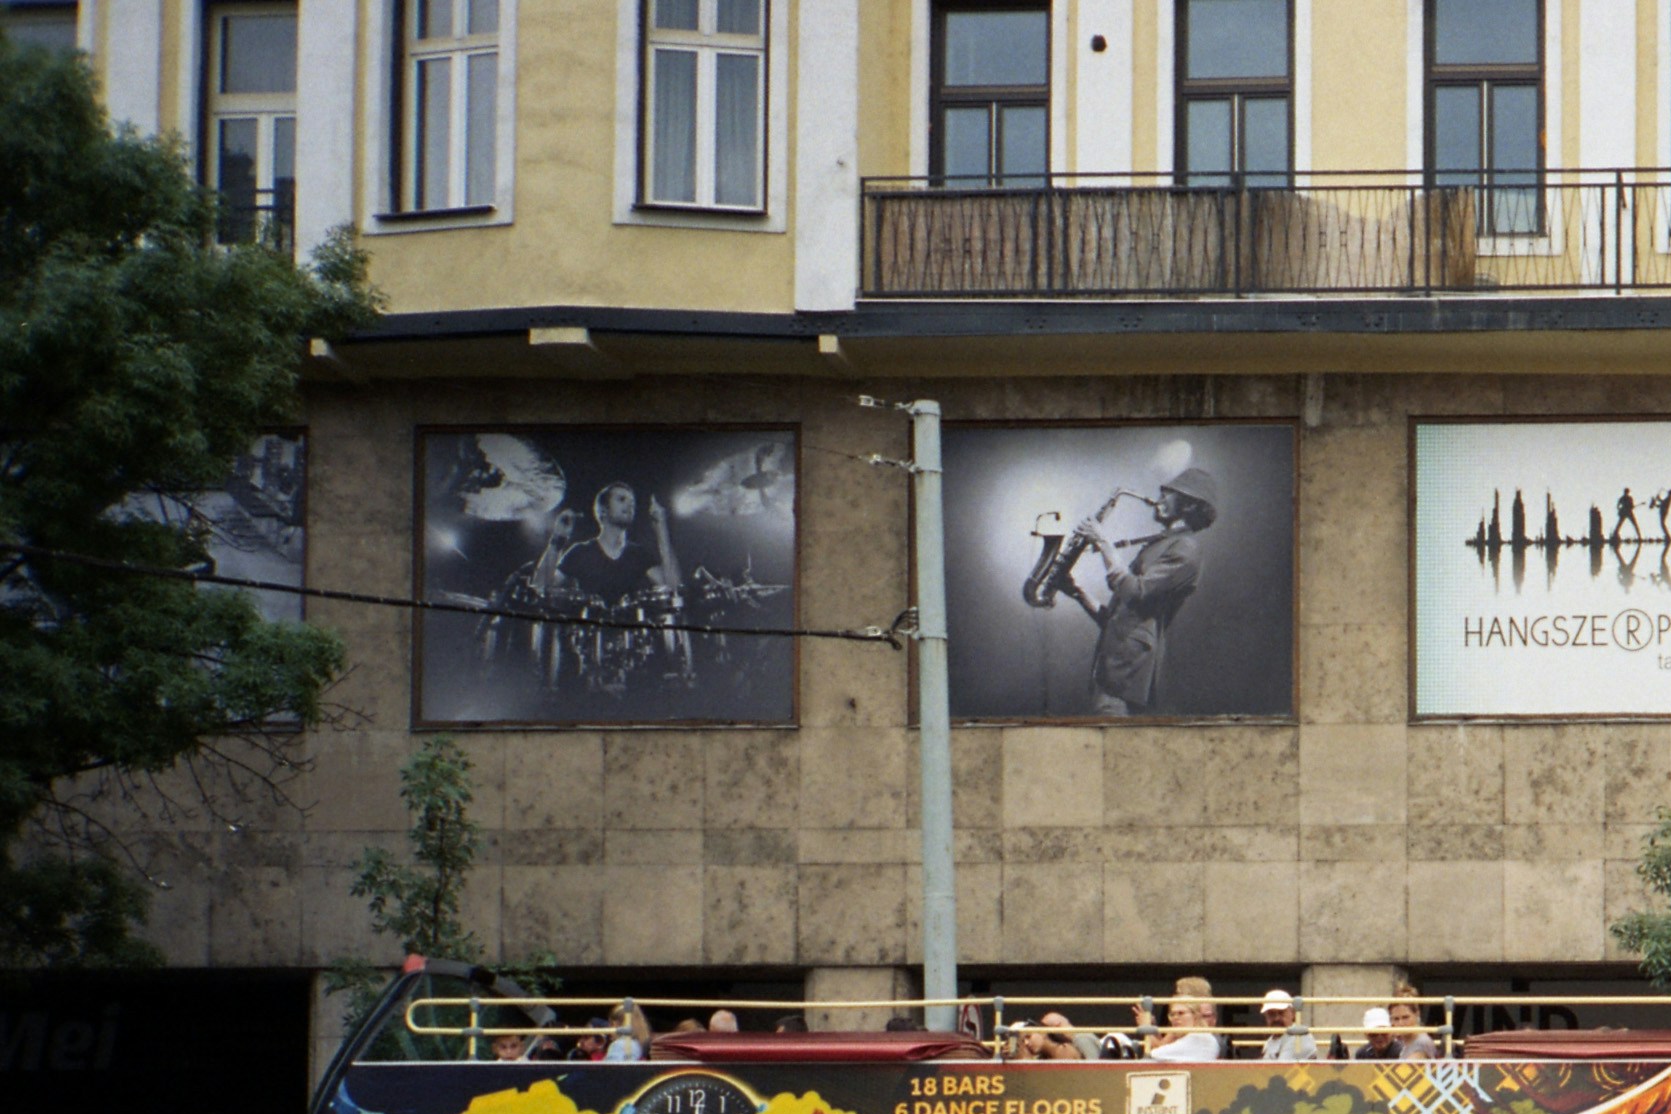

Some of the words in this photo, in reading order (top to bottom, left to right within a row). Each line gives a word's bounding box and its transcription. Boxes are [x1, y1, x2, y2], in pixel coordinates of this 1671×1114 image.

[910, 1077, 937, 1096] 18
[942, 1075, 1005, 1096] BARS
[667, 1095, 681, 1113] 11
[689, 1089, 705, 1108] 12
[719, 1095, 725, 1113] 1
